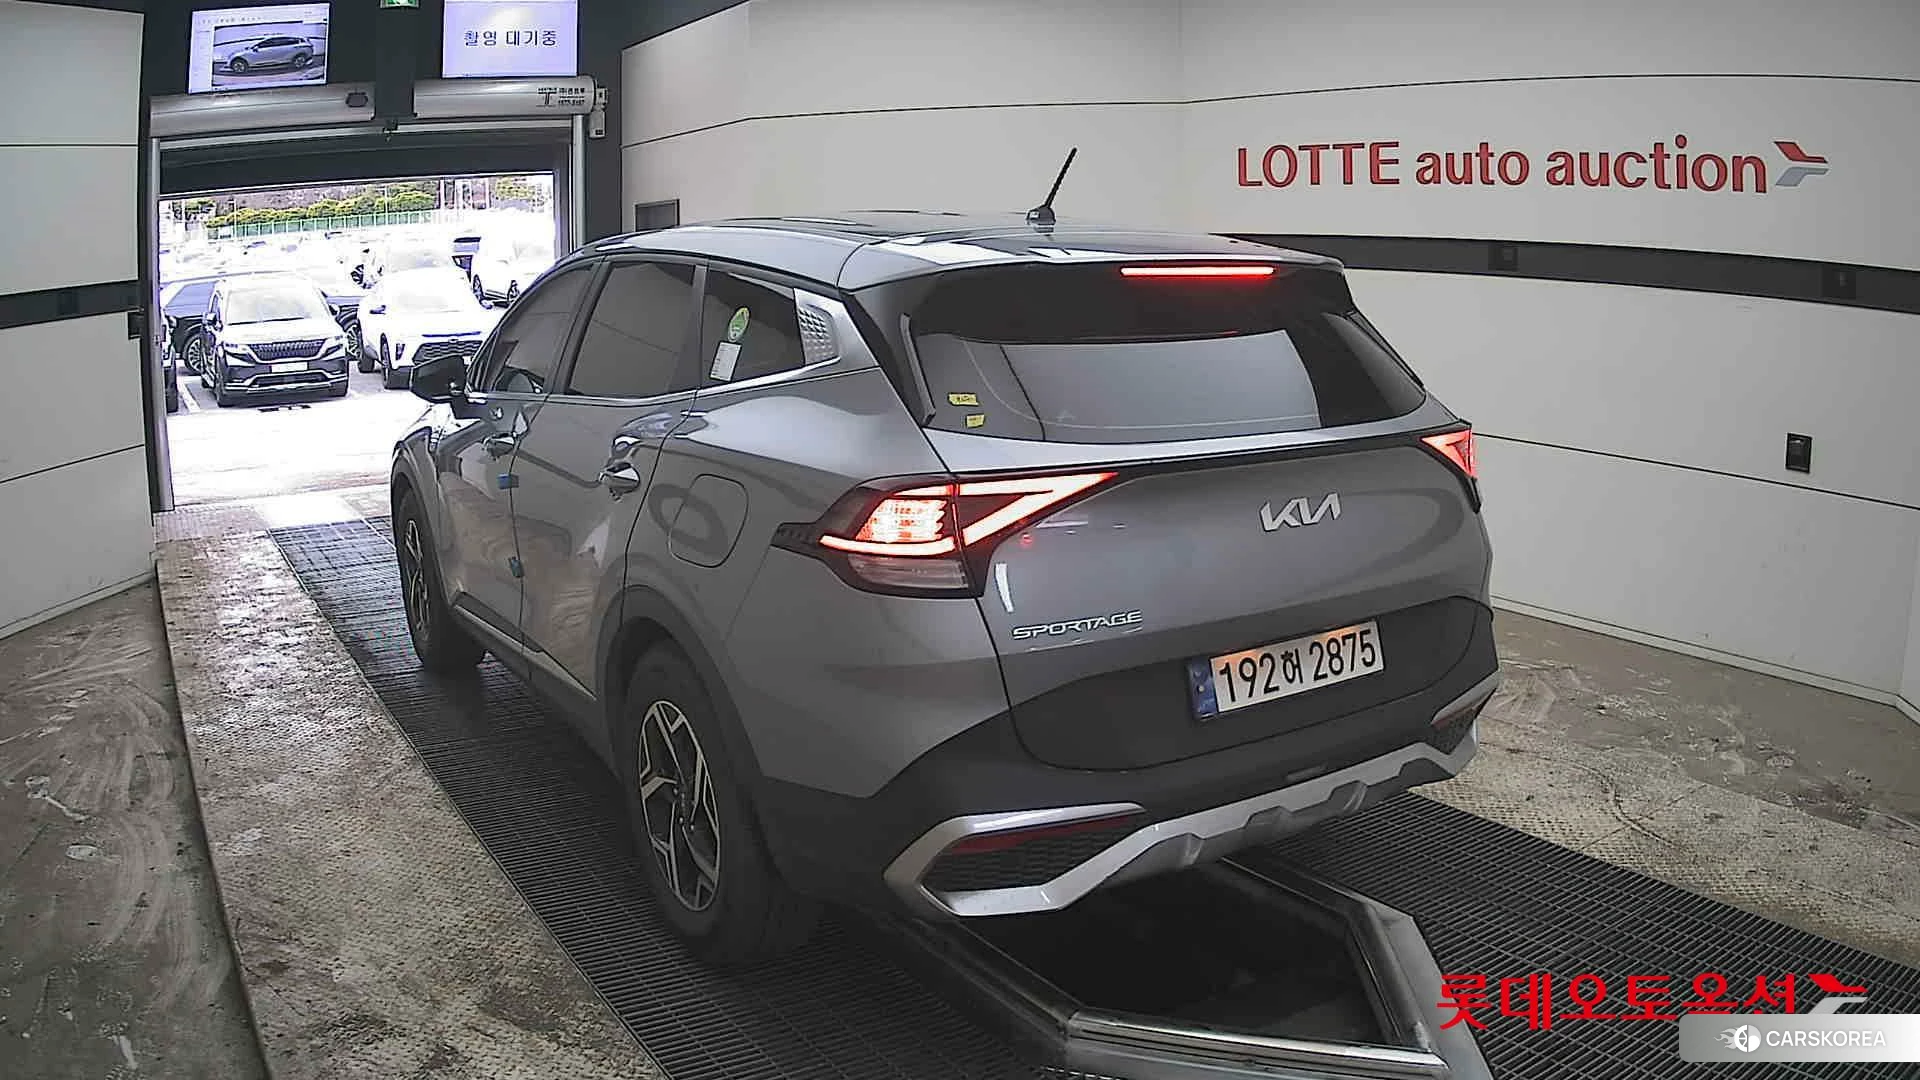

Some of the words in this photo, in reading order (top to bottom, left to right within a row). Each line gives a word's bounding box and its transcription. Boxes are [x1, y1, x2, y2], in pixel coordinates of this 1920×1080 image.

[506, 30, 556, 46] 대기중
[1237, 141, 1400, 188] LOTTE
[1415, 142, 1530, 186] auto
[1546, 134, 1767, 194] auction
[1260, 492, 1342, 531] KIA
[1013, 610, 1143, 640] SPORTAGE
[1219, 648, 1304, 703] 192허
[1309, 628, 1376, 682] 2875
